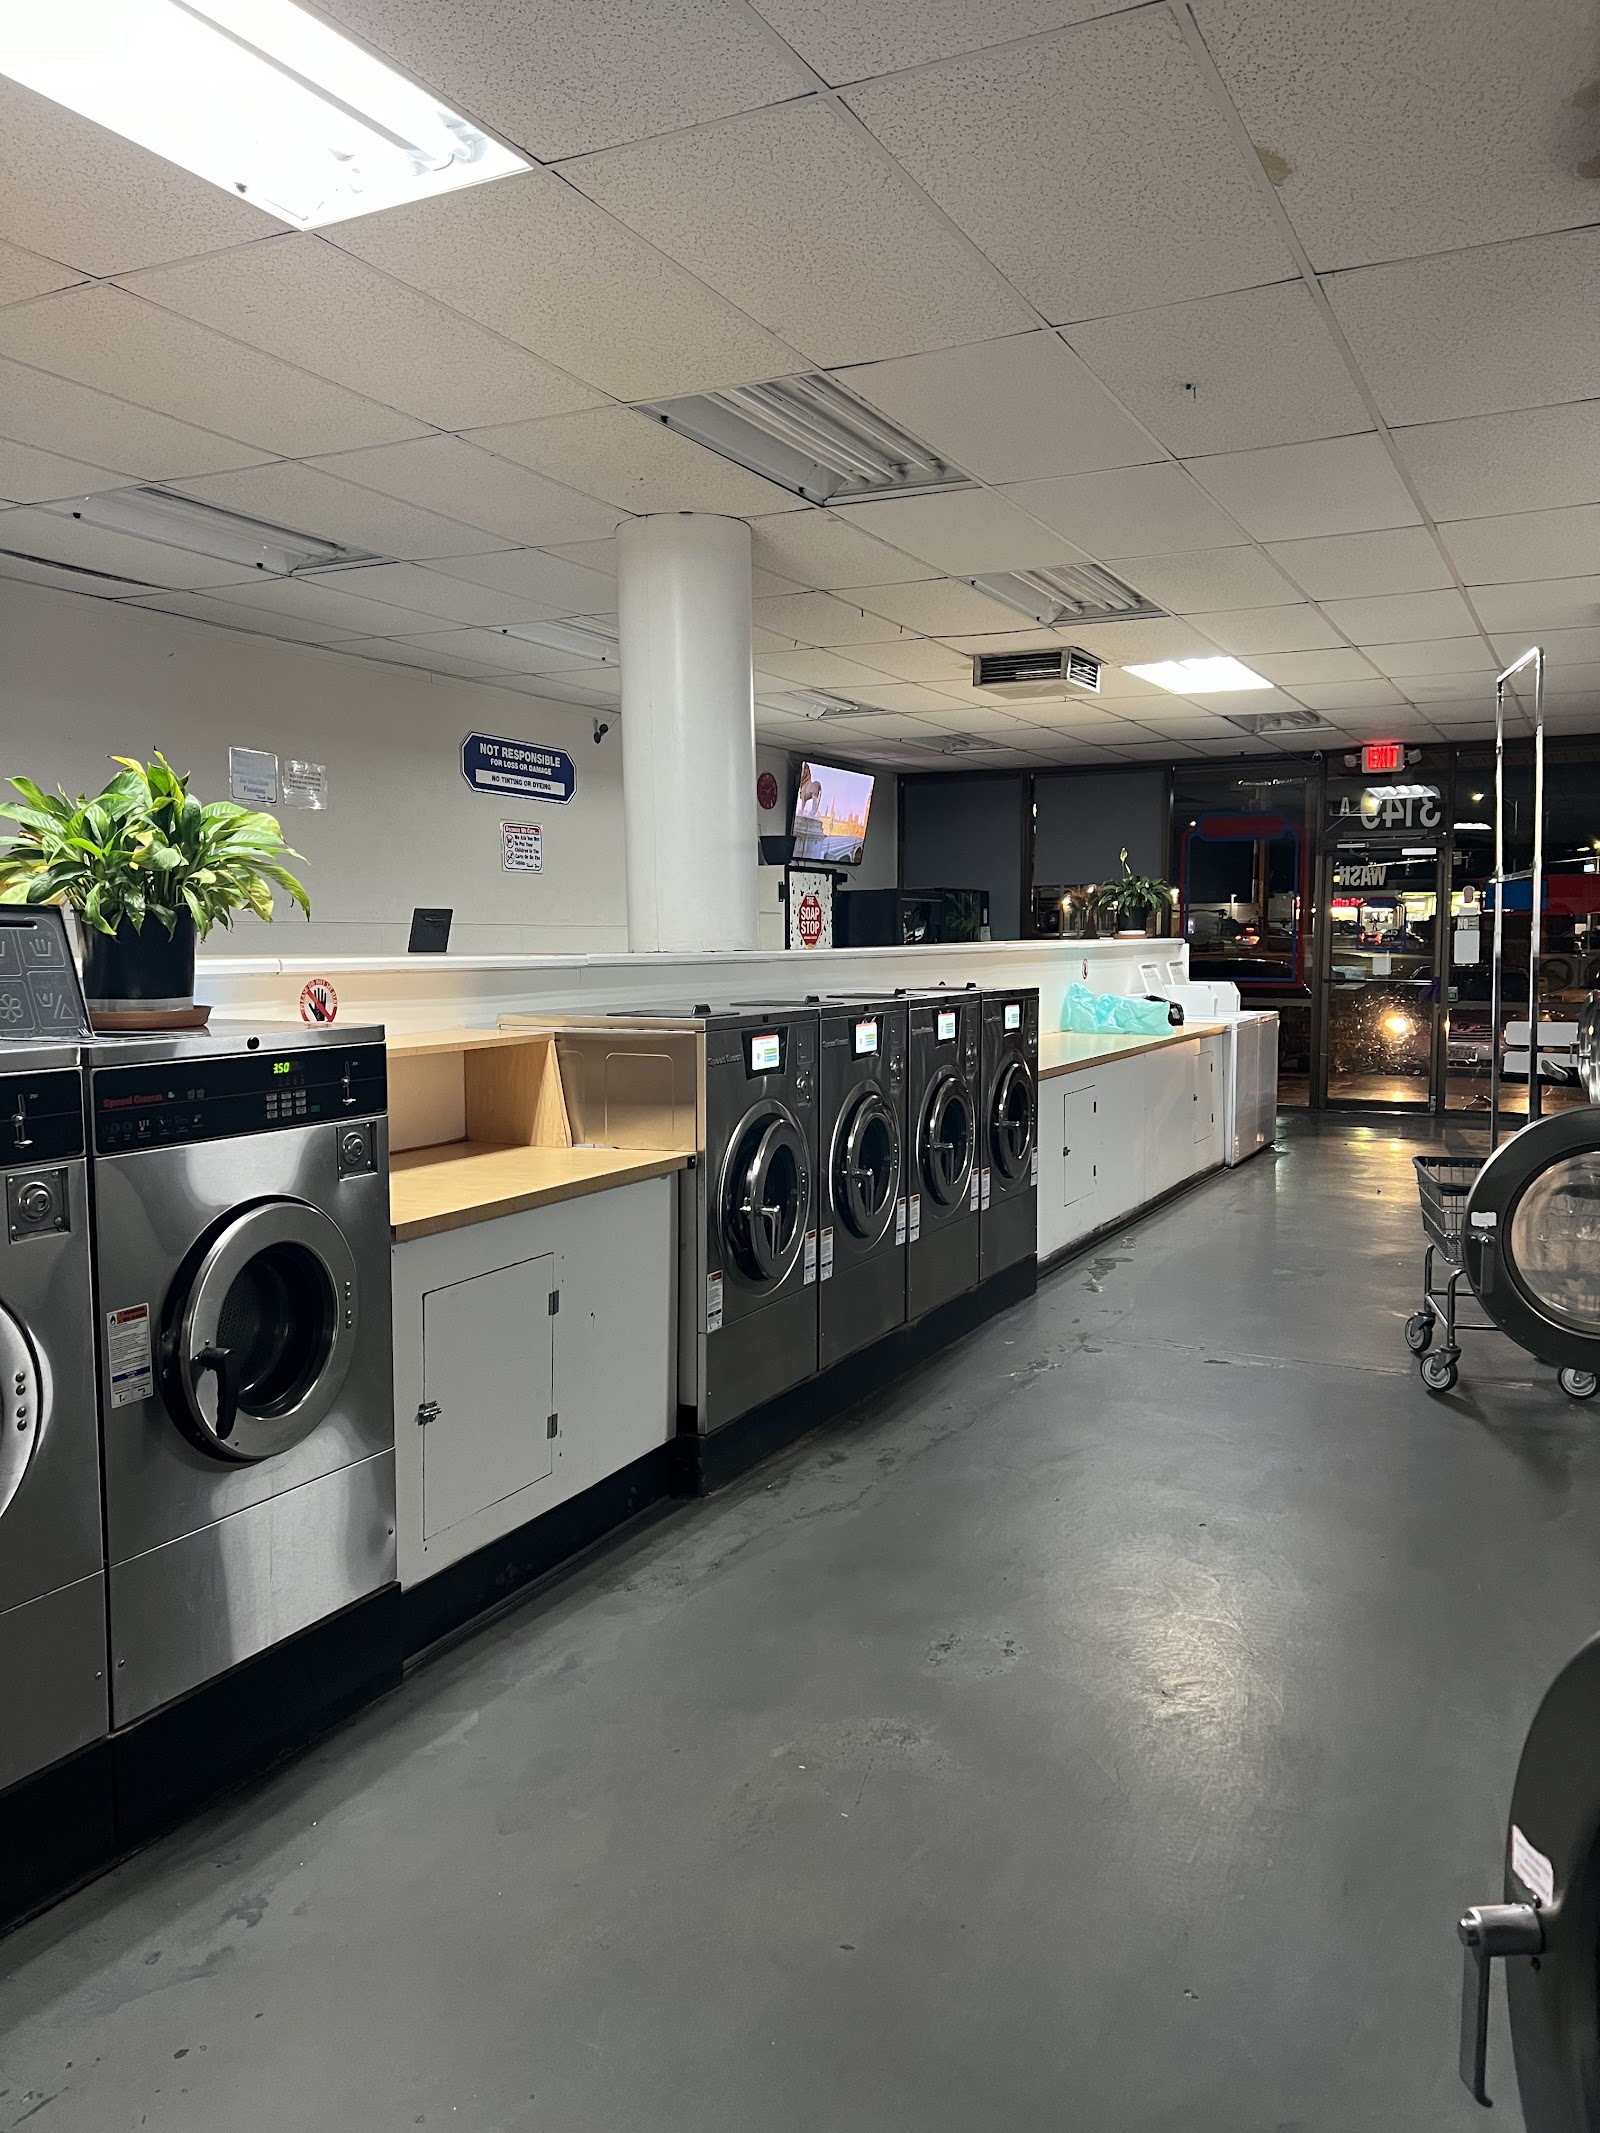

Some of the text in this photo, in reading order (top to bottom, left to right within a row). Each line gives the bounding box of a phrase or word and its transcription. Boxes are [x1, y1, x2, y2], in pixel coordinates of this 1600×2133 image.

[480, 743, 561, 767] NOT RESPONSIBLE
[1368, 745, 1399, 769] EXIT
[490, 758, 552, 775] FOR LOSS OR DAMAGE
[501, 776, 523, 786] TINTING
[532, 782, 552, 790] DYEING
[806, 897, 815, 905] THE
[801, 907, 820, 920] SOAP
[801, 920, 820, 934] STOP
